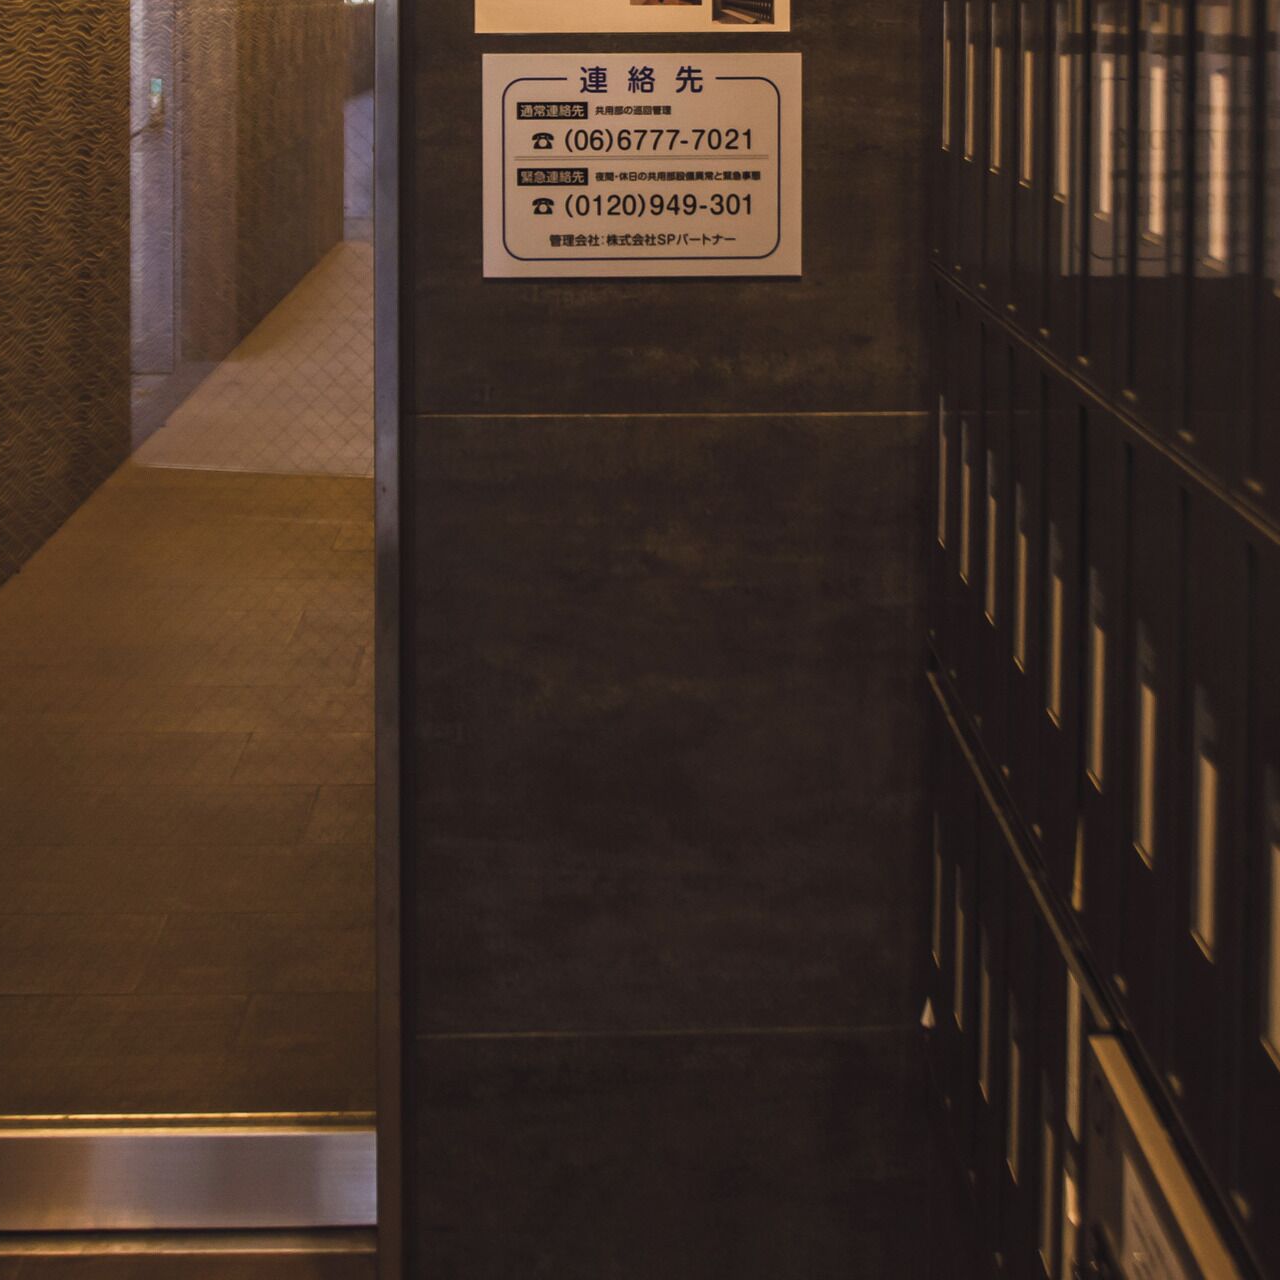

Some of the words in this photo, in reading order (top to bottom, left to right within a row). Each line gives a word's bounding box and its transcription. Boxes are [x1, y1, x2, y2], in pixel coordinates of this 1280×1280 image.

[579, 65, 704, 94] 連絡先
[520, 104, 585, 118] 通常連絡先
[564, 128, 753, 152] (06)6777-7021
[520, 171, 585, 185] 緊急連絡先
[564, 193, 753, 218] (0120)949-301
